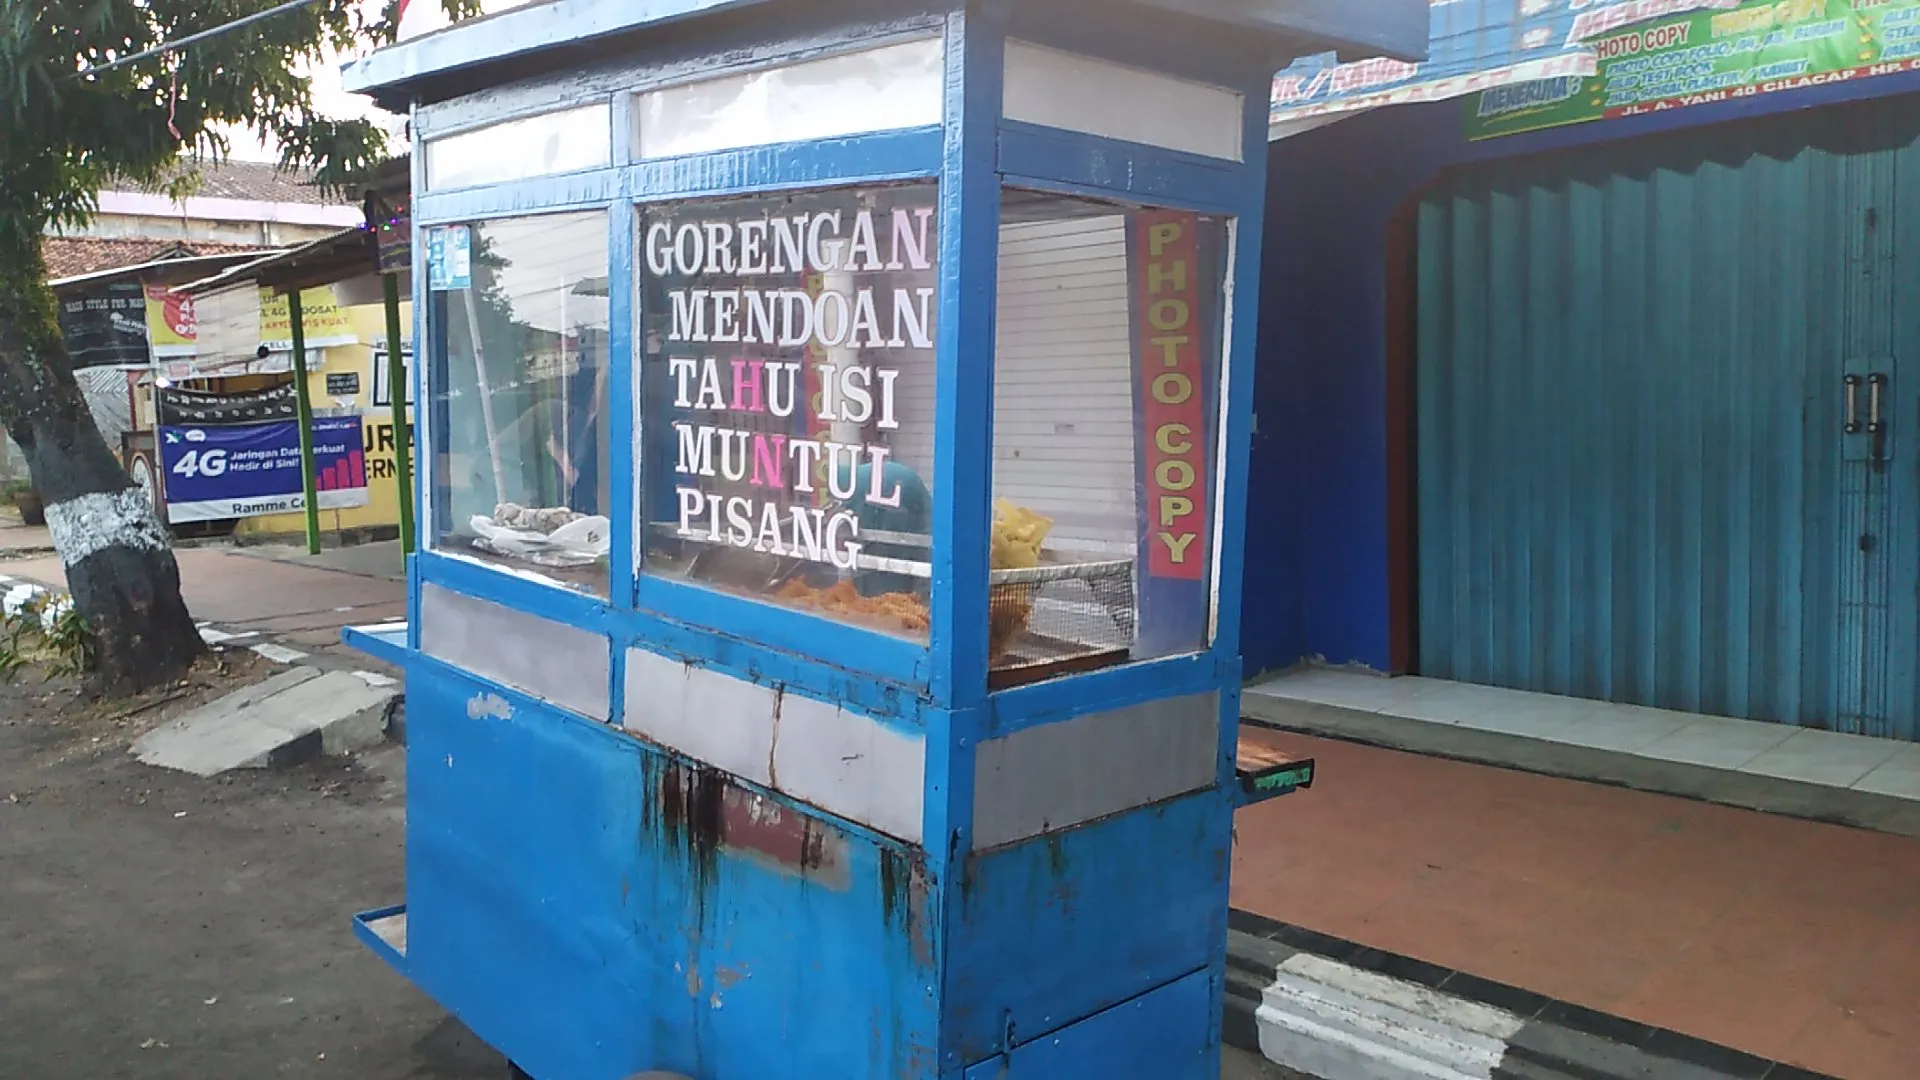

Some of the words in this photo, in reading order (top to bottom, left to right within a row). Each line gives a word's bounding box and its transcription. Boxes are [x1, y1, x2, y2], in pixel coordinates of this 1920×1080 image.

[1597, 34, 1640, 59] HOTO
[1645, 23, 1689, 49] COPY
[1620, 104, 1649, 117] JL.
[1654, 100, 1674, 112] A.
[1680, 90, 1727, 106] YANI
[1762, 69, 1857, 93] CILACAP
[646, 207, 934, 277] GORENGAN
[668, 286, 934, 349] MENDOAN
[1148, 222, 1193, 405] PHOTO
[669, 356, 800, 418] TAHU
[817, 362, 899, 429] ISI
[172, 449, 227, 478] 4G
[229, 461, 259, 473] Hadir
[262, 459, 273, 470] di
[230, 449, 278, 462] Jaringan
[312, 443, 345, 456] erkuat
[674, 423, 901, 509] MUNTUL
[232, 501, 286, 515] Ramme
[1154, 423, 1197, 564] COPY
[675, 486, 862, 569] PISANG
